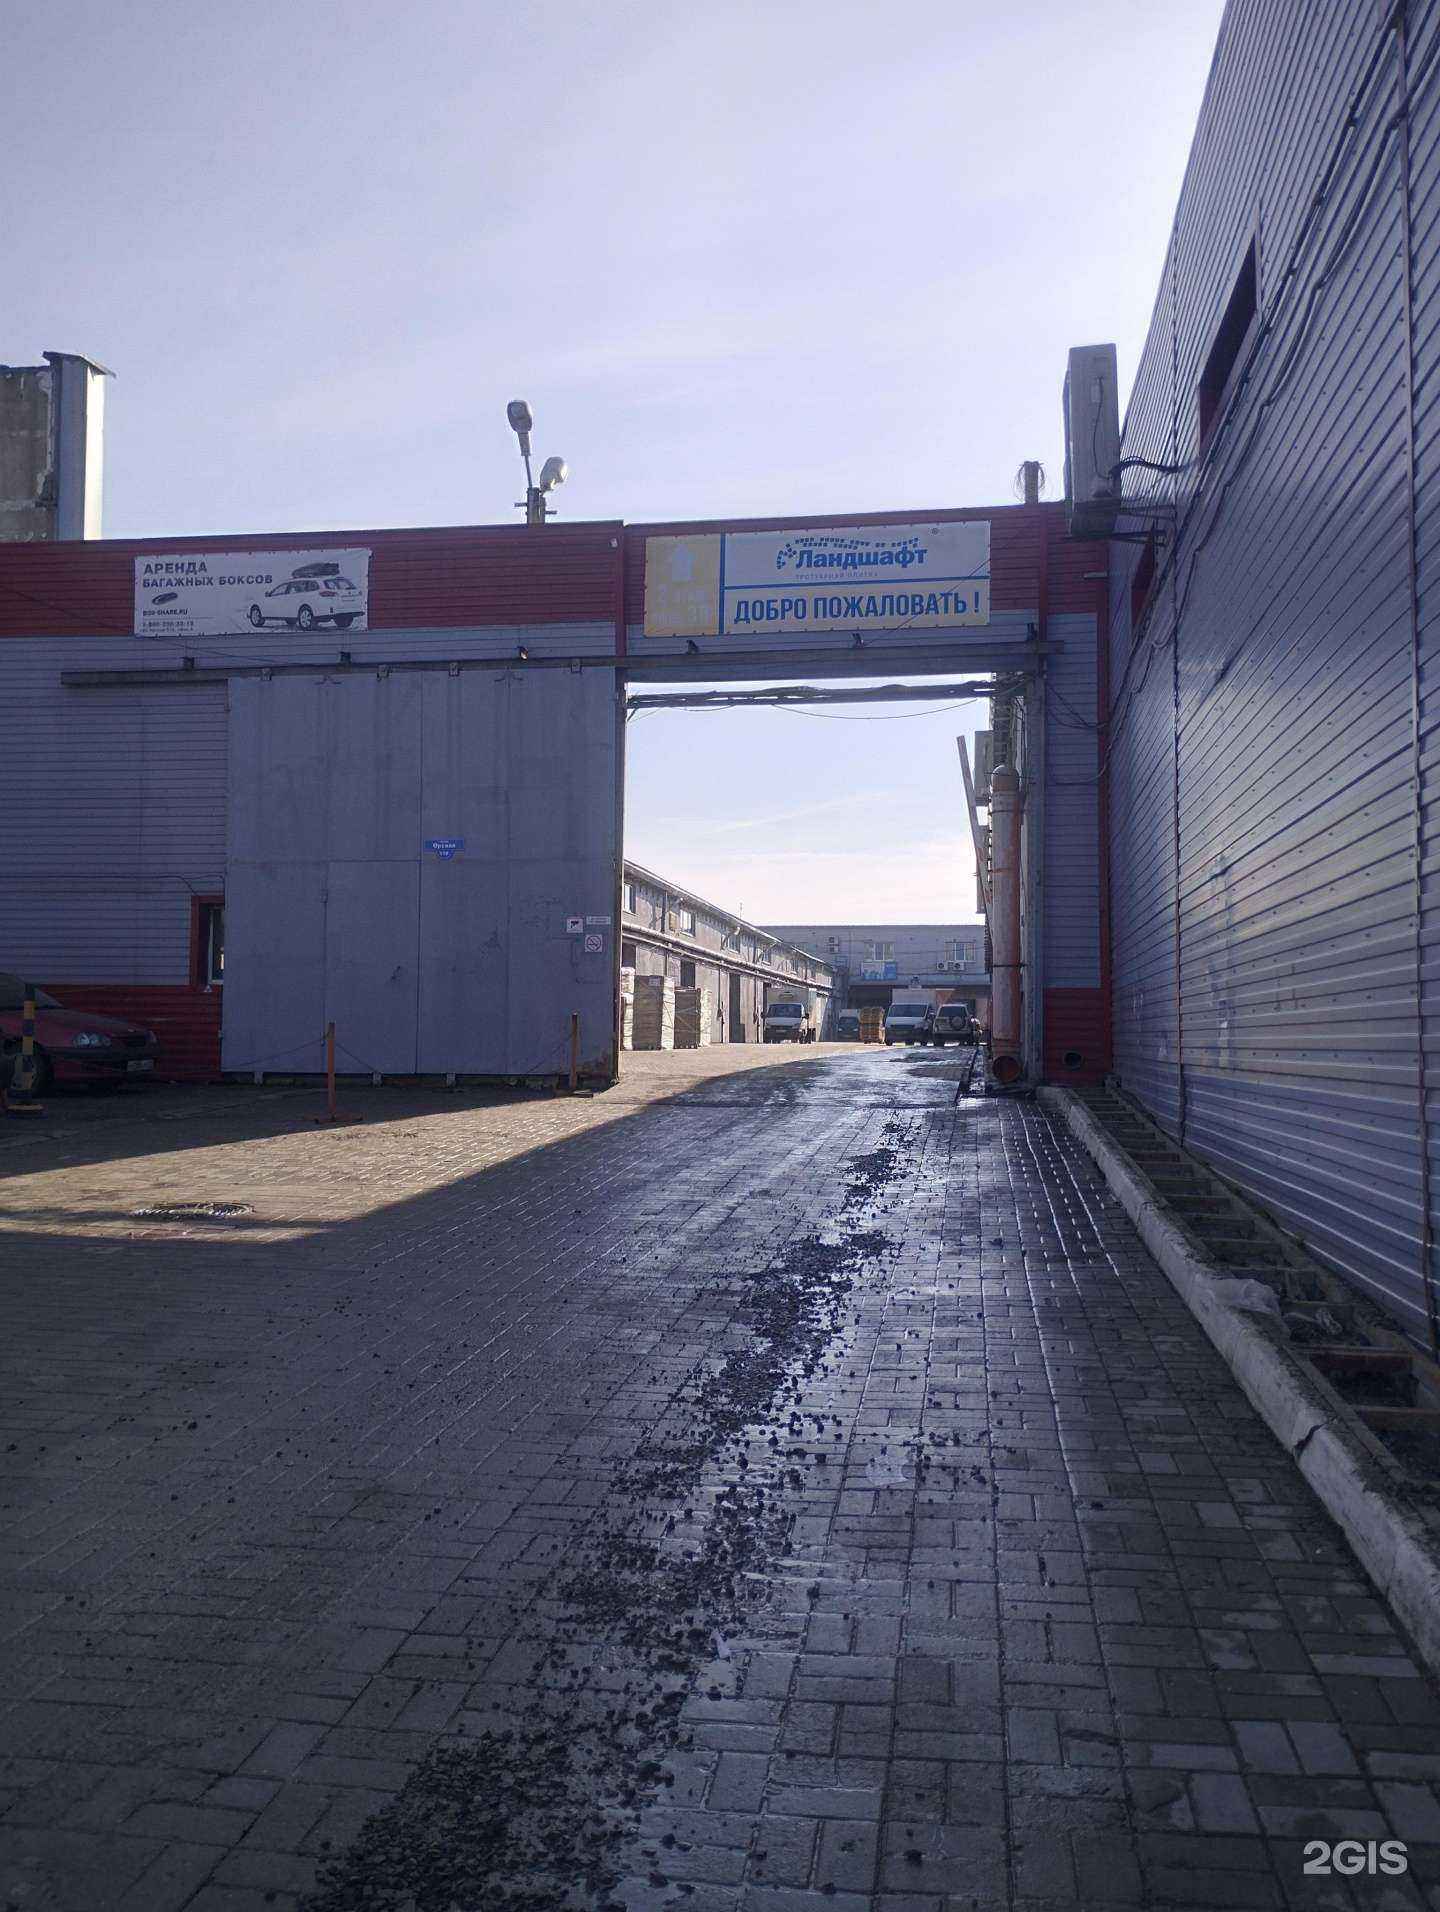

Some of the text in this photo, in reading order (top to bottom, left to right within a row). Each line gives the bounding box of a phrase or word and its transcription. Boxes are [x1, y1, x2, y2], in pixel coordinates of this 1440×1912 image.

[795, 546, 927, 569] Ландшафт
[144, 561, 207, 575] АРЕНДА
[143, 575, 273, 588] БАГАЖНЫХ БОКСОВ
[734, 598, 807, 624] ДОБРО
[814, 592, 967, 619] ПОЖАЛОВАТЬ
